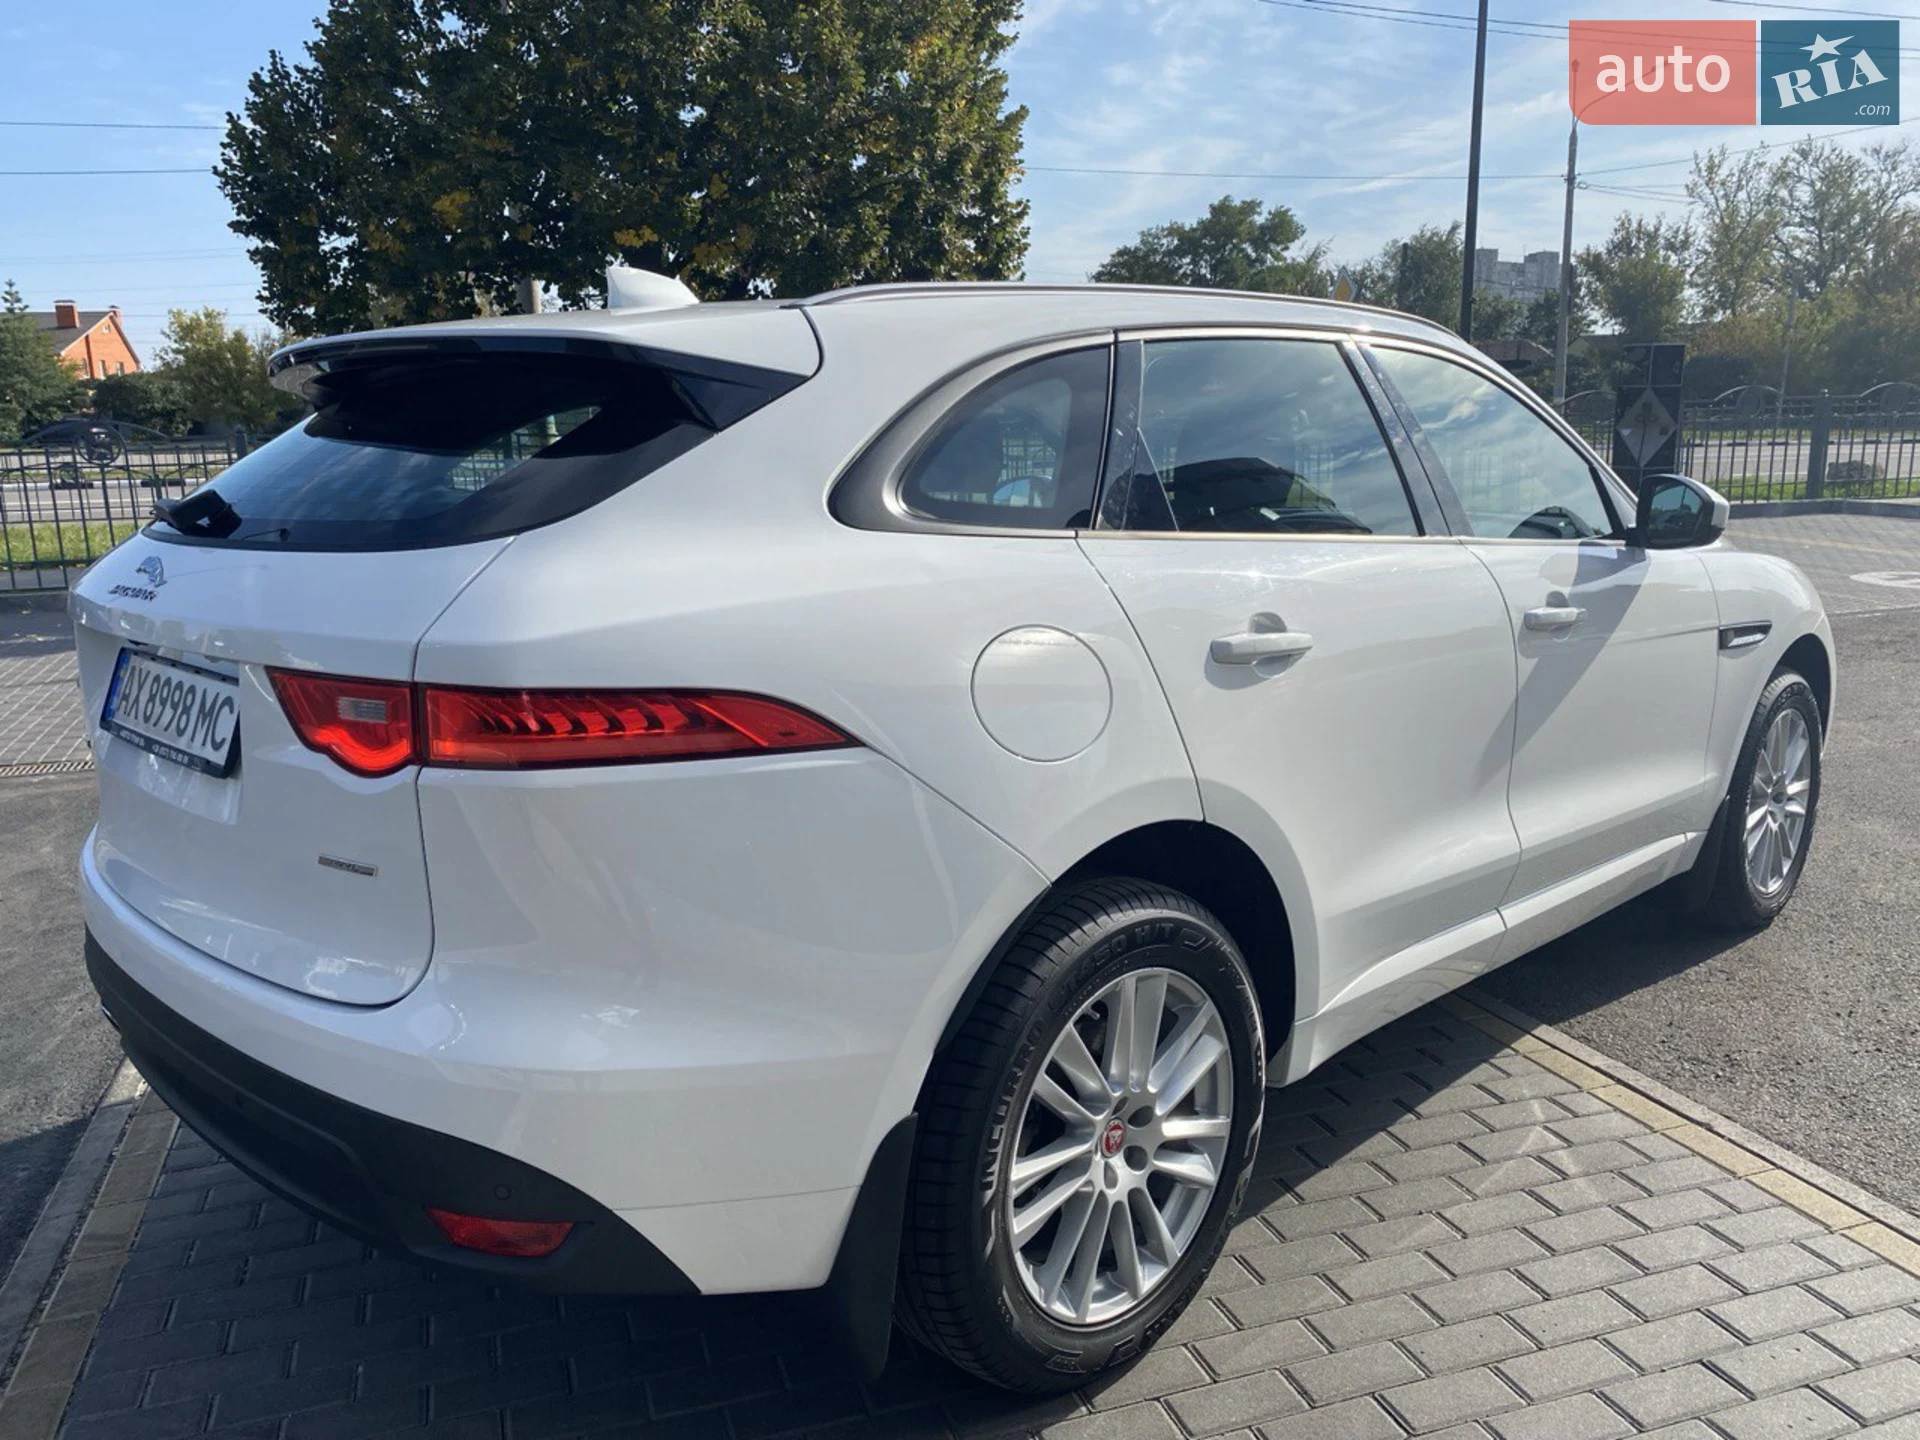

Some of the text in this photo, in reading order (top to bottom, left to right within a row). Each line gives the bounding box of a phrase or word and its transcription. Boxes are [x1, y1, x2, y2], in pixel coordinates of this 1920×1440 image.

[117, 665, 235, 752] AX 8998 MC
